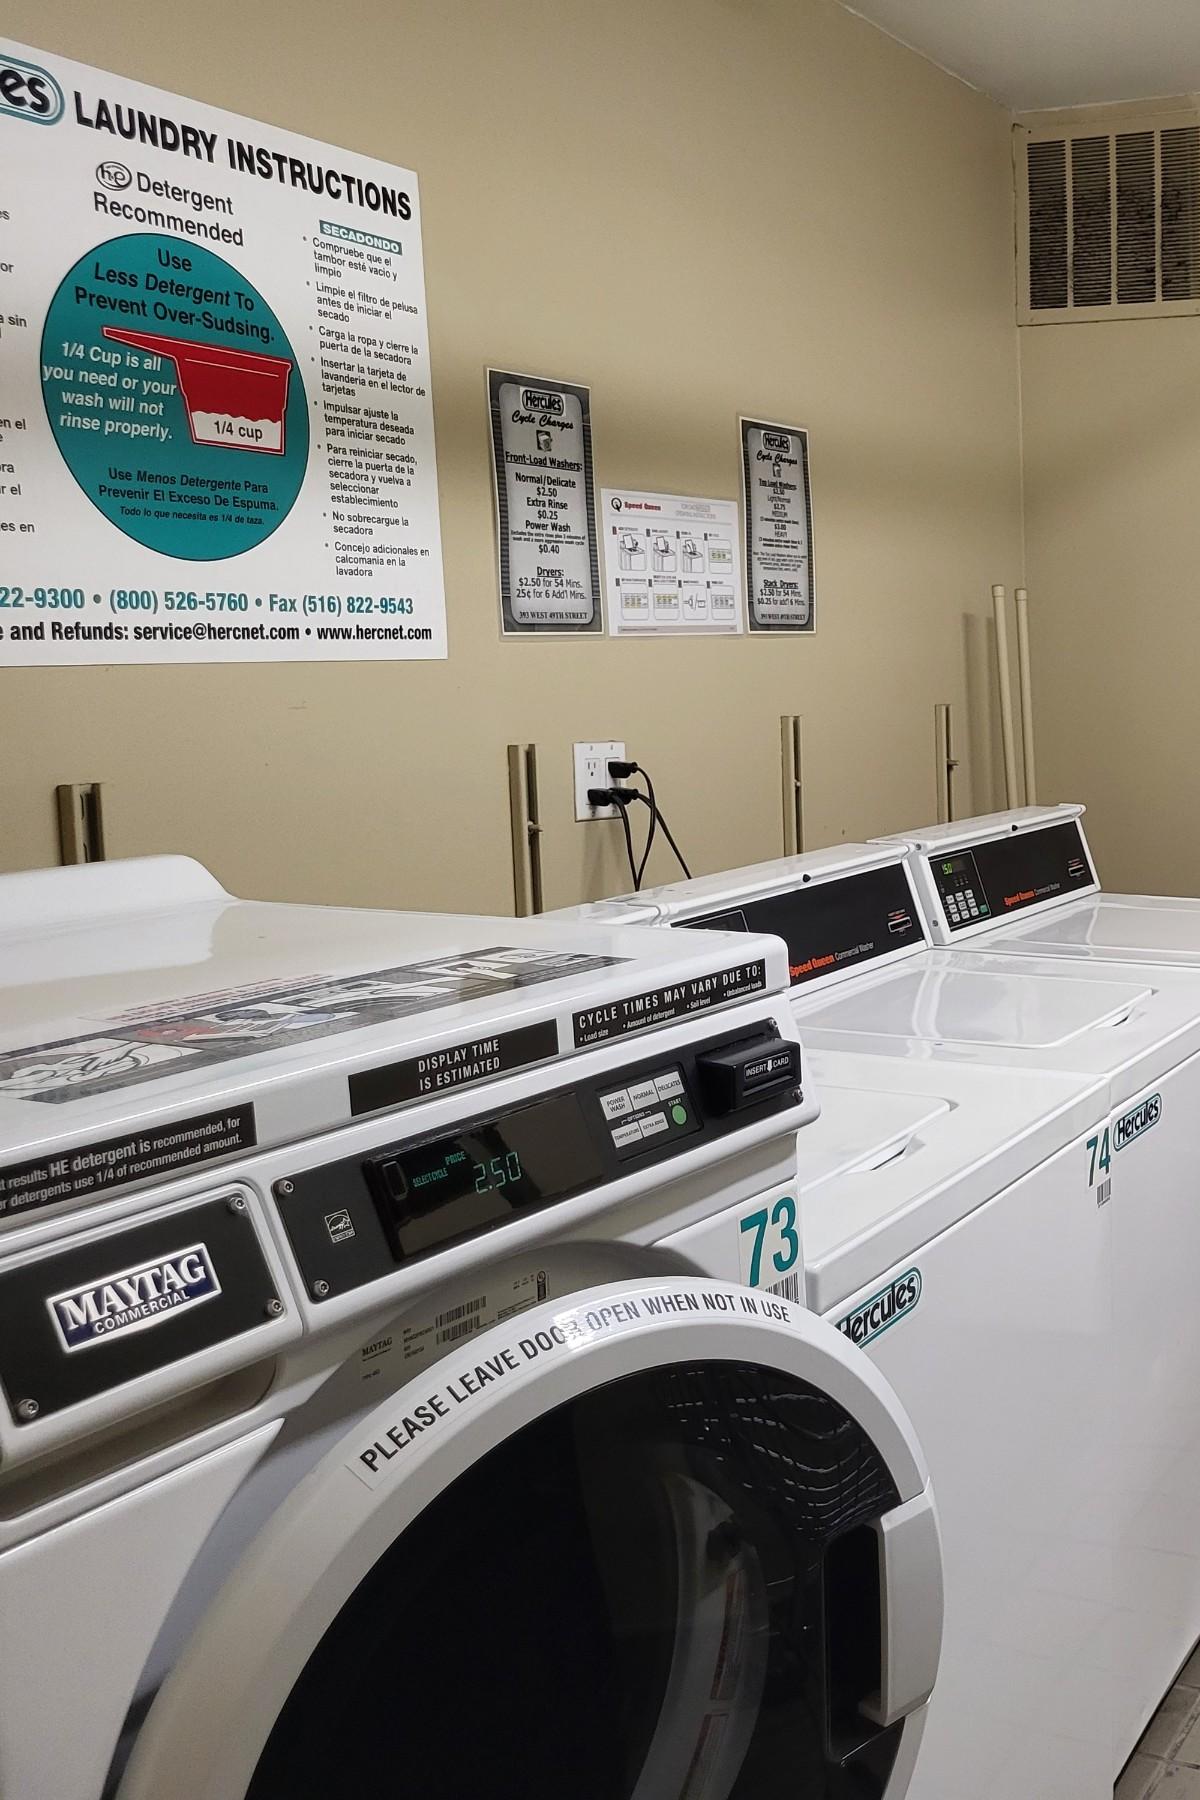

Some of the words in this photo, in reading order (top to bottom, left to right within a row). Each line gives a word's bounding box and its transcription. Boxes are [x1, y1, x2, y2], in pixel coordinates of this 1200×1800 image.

[73, 91, 217, 162] LAUNDRY
[228, 138, 411, 220] INSTRUCTIONS
[137, 172, 234, 216] Detergent
[94, 191, 244, 247] Recommended
[322, 223, 399, 252] SECADONDO
[157, 248, 192, 272] Use
[313, 237, 364, 259] Compruebe
[367, 253, 382, 265] que
[384, 256, 391, 266] el
[314, 250, 345, 266] tambor
[348, 260, 366, 272] esté
[392, 272, 397, 282] y
[314, 263, 342, 278] limpio
[94, 262, 138, 287] Less
[145, 273, 230, 307] Detergent
[234, 291, 254, 312] To
[75, 286, 147, 317] Prevent
[154, 302, 275, 344] Over-Sudsing.
[61, 342, 84, 359] 1/4
[89, 346, 121, 368] Cup
[126, 351, 139, 368] is
[143, 355, 162, 372] all
[42, 365, 74, 382] you
[78, 368, 117, 388] need
[121, 374, 138, 390] or
[143, 379, 177, 396] your
[61, 391, 104, 408] wash
[109, 395, 135, 413] will
[139, 400, 164, 416] not
[525, 391, 561, 411] Hercules
[59, 413, 101, 431] rinse
[104, 416, 173, 441] properly.
[214, 420, 234, 436] 1/4
[238, 425, 263, 441] cup
[505, 451, 547, 466] Front-Load
[549, 457, 583, 471] Washers:
[108, 467, 132, 481] Use
[136, 470, 176, 486] Menos
[180, 475, 241, 492] Detergente
[244, 480, 268, 494] Para
[330, 482, 379, 494] seleccionar
[515, 472, 576, 488] Normal/Delicate
[536, 487, 558, 498] $2.50
[99, 485, 149, 501] Prevenir
[153, 489, 165, 502] El
[169, 491, 211, 506] Exceso
[214, 493, 230, 507] De
[232, 496, 279, 512] Espuma.
[331, 494, 398, 508] establecimiento
[527, 496, 547, 508] Extra
[548, 498, 568, 510] Rinse
[526, 520, 549, 531] Power
[550, 521, 571, 532] Wash
[538, 510, 558, 520] $0.25
[539, 545, 560, 554] $0.40
[537, 566, 564, 577] Dryers:
[109, 589, 159, 614] (800)
[164, 591, 248, 612] 526-5760
[269, 594, 297, 613] Fax
[302, 594, 342, 618] (516)
[347, 596, 414, 614] 822-9543
[10, 622, 45, 641] and
[51, 622, 129, 641] Refunds:
[133, 622, 300, 641] service@hercnet.com
[317, 624, 432, 640] www.hercnet.com
[790, 961, 812, 977] Speed
[812, 955, 835, 969] Queen
[579, 1008, 618, 1029] CYCLE
[623, 994, 659, 1016] TIMES
[664, 986, 686, 1004] MAY
[691, 977, 718, 995] VARY
[722, 970, 742, 986] DUE
[745, 965, 761, 979] TO:
[584, 1031, 598, 1042] Load
[598, 1029, 609, 1039] size
[626, 1017, 646, 1029] Amount
[652, 1007, 675, 1022] detergent
[418, 1048, 467, 1073] DISPLAY
[472, 1039, 500, 1057] TIME
[745, 1063, 767, 1077] INSERT
[772, 1056, 789, 1069] CARD
[419, 1077, 432, 1091] IS
[436, 1056, 500, 1086] ESTIMATED
[606, 1096, 625, 1107] POWER
[610, 1102, 626, 1113] WASH
[633, 1089, 655, 1101] NORMAL
[1118, 1100, 1159, 1145] Hercules
[9, 1168, 48, 1190] results
[50, 1158, 70, 1178] HE
[72, 1141, 137, 1173] detergent
[138, 1138, 151, 1154] is
[153, 1121, 226, 1150] recommended,
[227, 1115, 241, 1130] for
[445, 1151, 467, 1166] PRICE
[1086, 1126, 1111, 1187] 74
[11, 1182, 72, 1208] detergents
[75, 1176, 95, 1190] use
[96, 1166, 114, 1184] 1/4
[116, 1162, 129, 1178] of
[130, 1143, 201, 1174] recommended
[203, 1132, 243, 1153] amount.
[473, 1151, 522, 1194] 2.50
[740, 1196, 799, 1288] 73
[60, 1253, 207, 1331] MAYTAG
[94, 1289, 191, 1334] COMMERCIAL
[362, 1336, 393, 1357] MAYTAG
[359, 1398, 451, 1473] PLEASE
[446, 1346, 521, 1405] LEAVE
[585, 1302, 641, 1333] OPEN
[642, 1293, 700, 1321] WHEN
[703, 1292, 736, 1313] NOT
[740, 1296, 758, 1314] IN
[761, 1300, 791, 1323] USE
